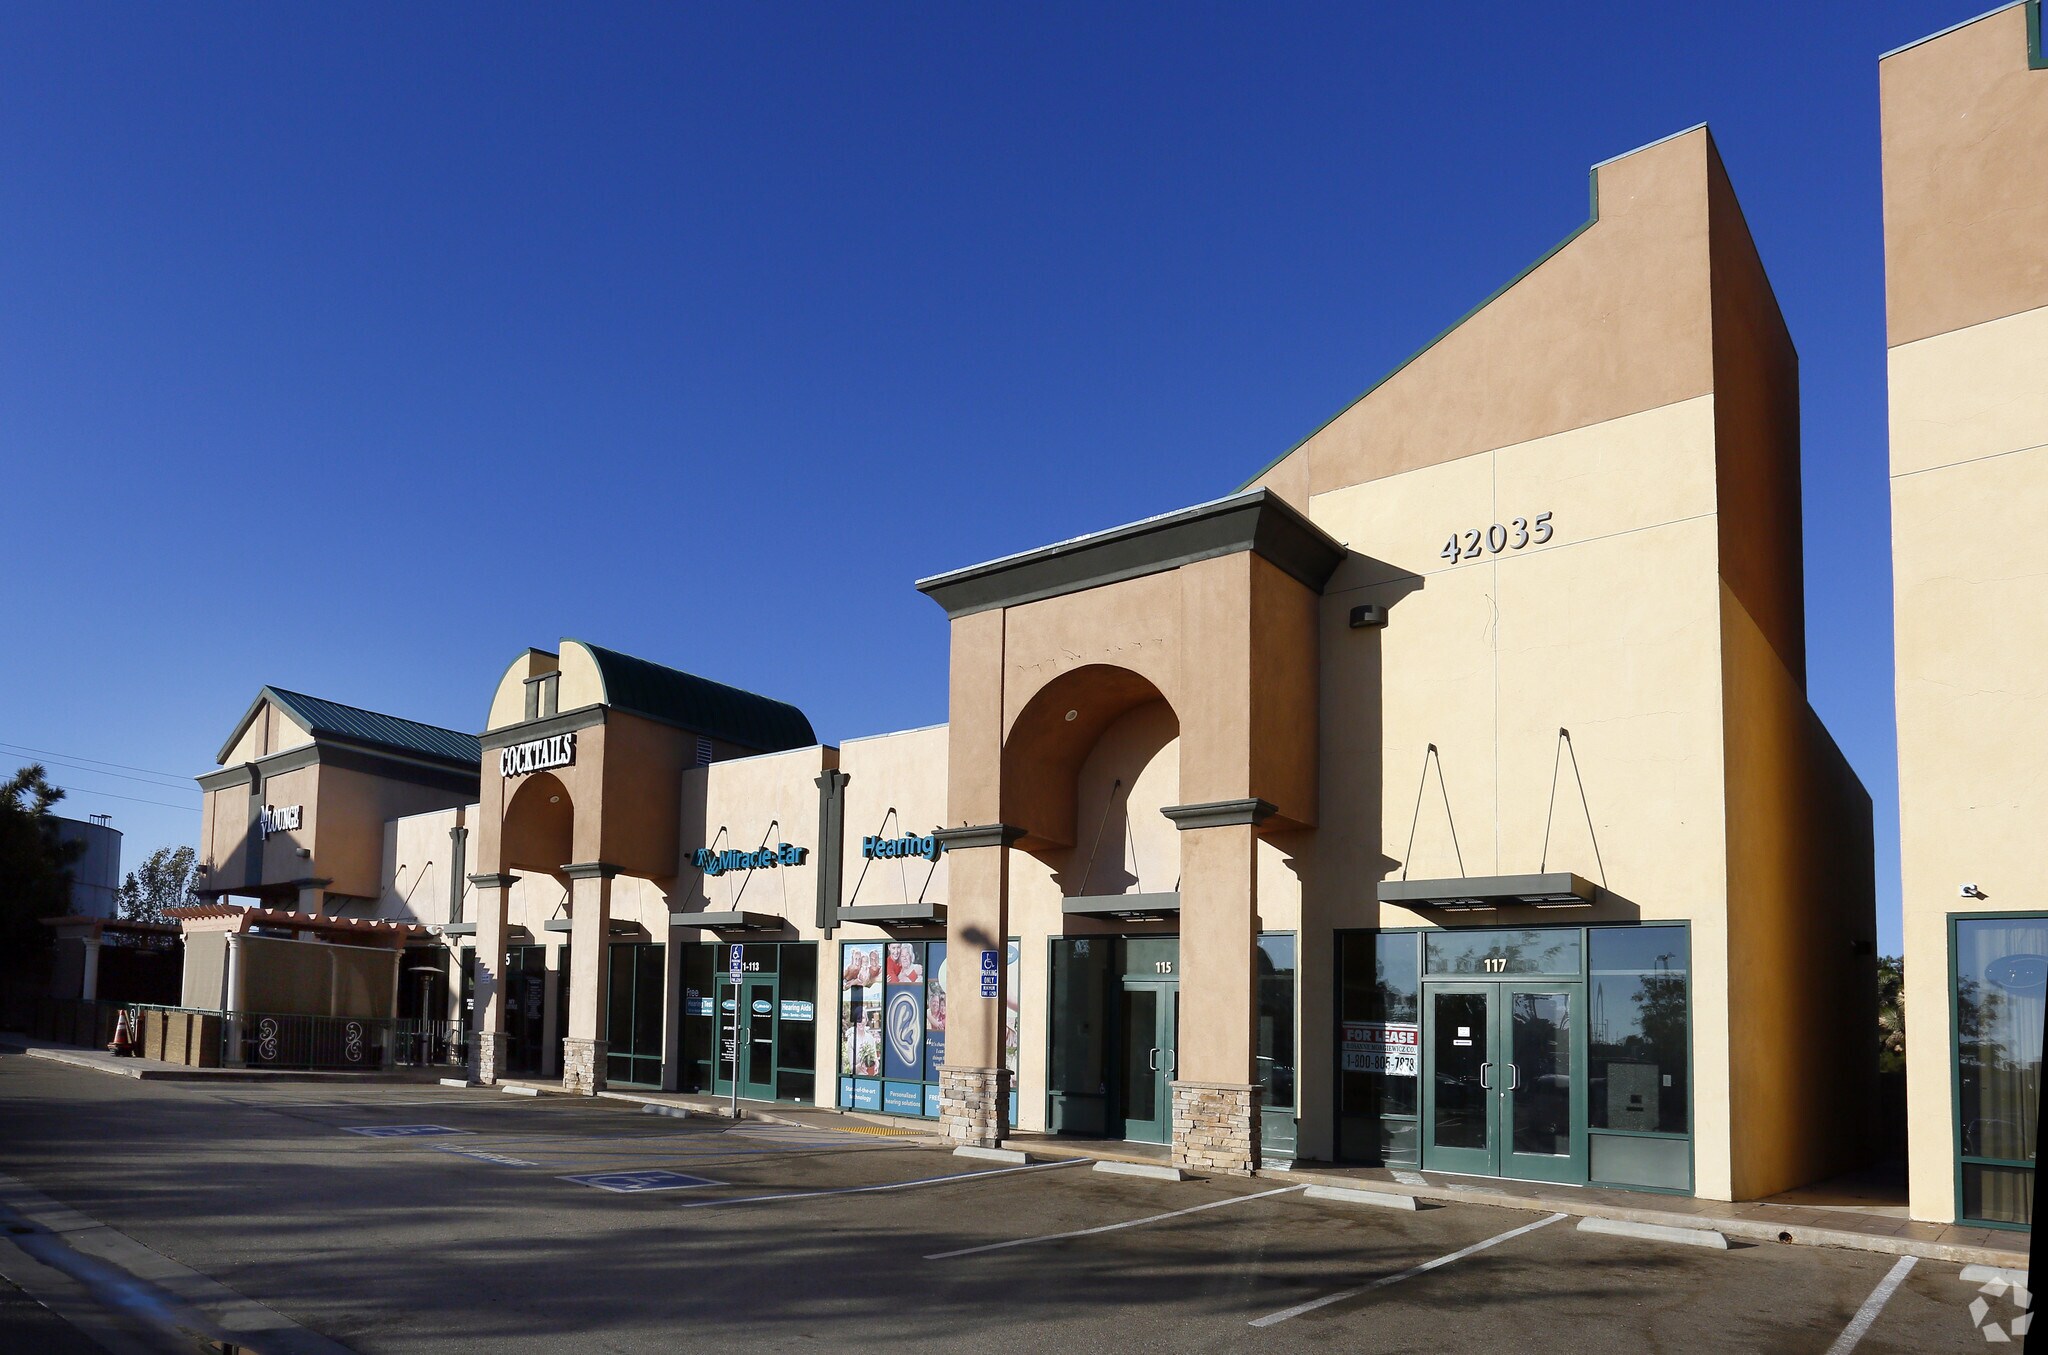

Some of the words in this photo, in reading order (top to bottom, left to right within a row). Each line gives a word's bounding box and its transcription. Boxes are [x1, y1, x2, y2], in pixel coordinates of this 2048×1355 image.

[1440, 511, 1554, 565] 42035
[500, 733, 572, 777] COCKTAILS
[267, 805, 299, 832] LOUNGE
[863, 831, 935, 860] Hearing
[719, 843, 803, 869] Miracle-Ear
[743, 961, 760, 972] 1-113
[1155, 961, 1172, 973] 115
[1484, 958, 1507, 973] 117
[686, 987, 699, 997] Free
[704, 1000, 713, 1008] Test
[781, 1003, 800, 1013] Hearing
[800, 1004, 812, 1012] Aids
[1346, 1029, 1371, 1042] FOR
[1375, 1030, 1415, 1044] LEASE
[889, 1091, 917, 1100] Personalized
[885, 1098, 900, 1107] hearing
